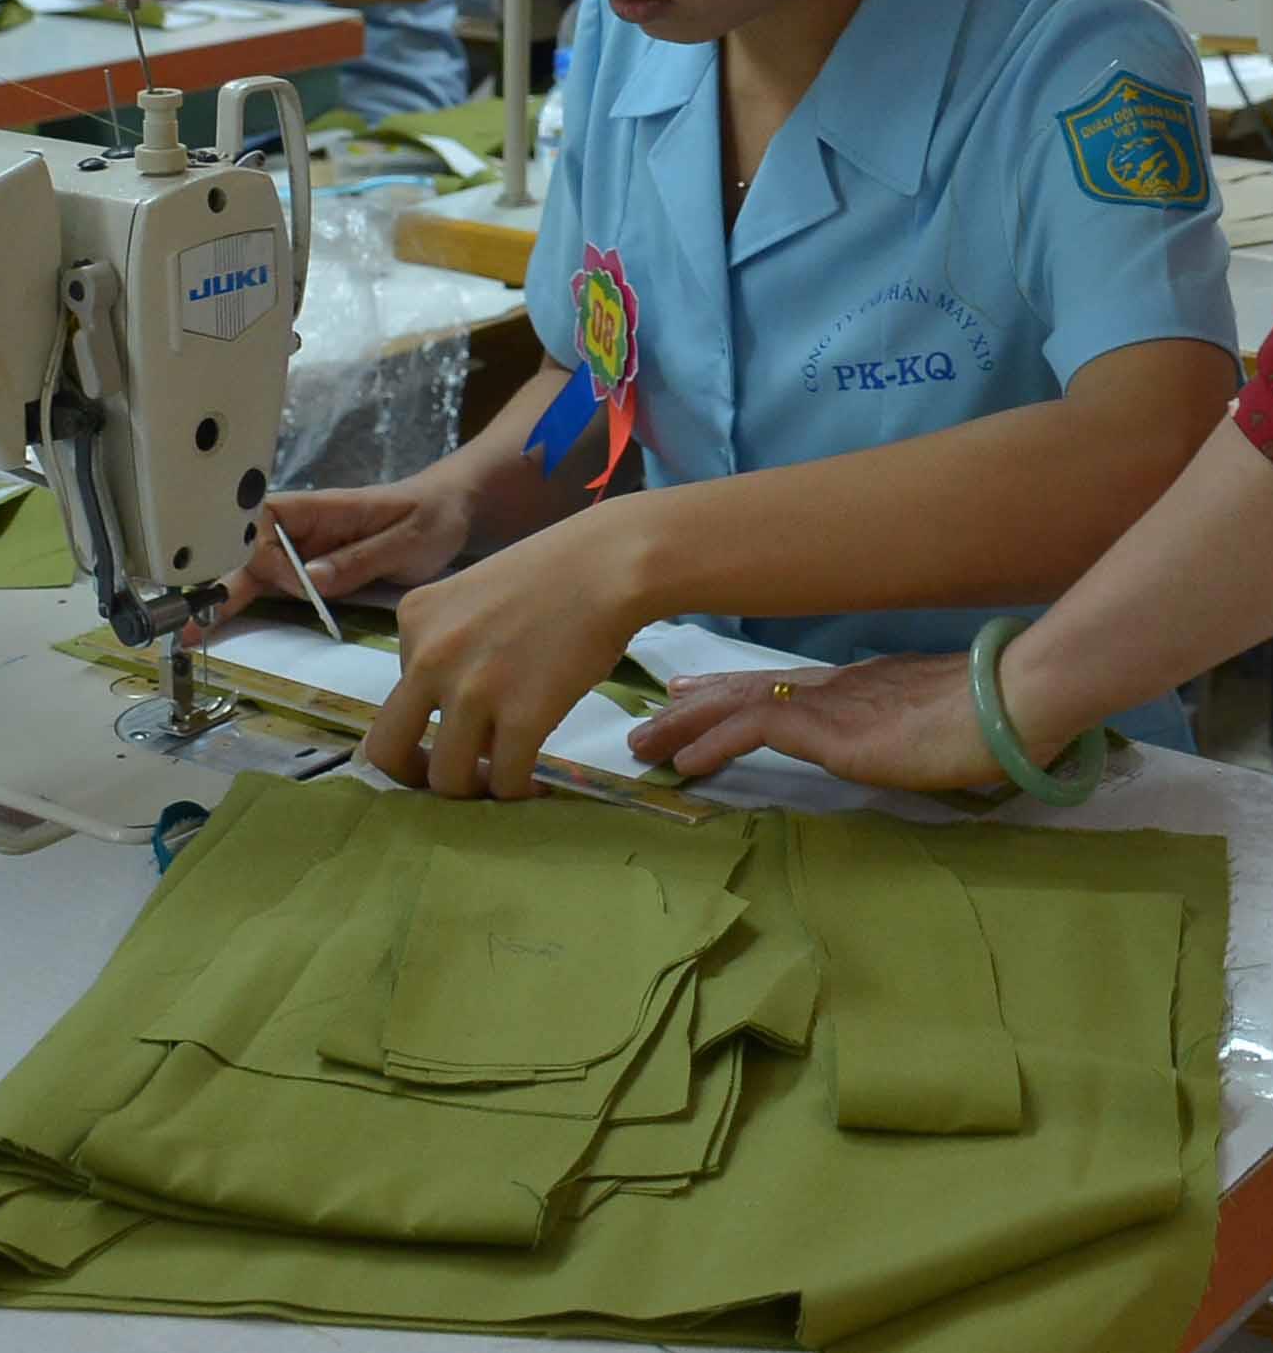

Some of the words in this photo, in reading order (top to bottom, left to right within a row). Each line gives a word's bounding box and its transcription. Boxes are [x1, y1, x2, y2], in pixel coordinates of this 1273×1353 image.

[189, 265, 268, 301] JUKI
[591, 300, 615, 358] 08
[935, 293, 978, 331] MAY
[968, 332, 995, 373] X19
[833, 350, 957, 391] PK-KQ
